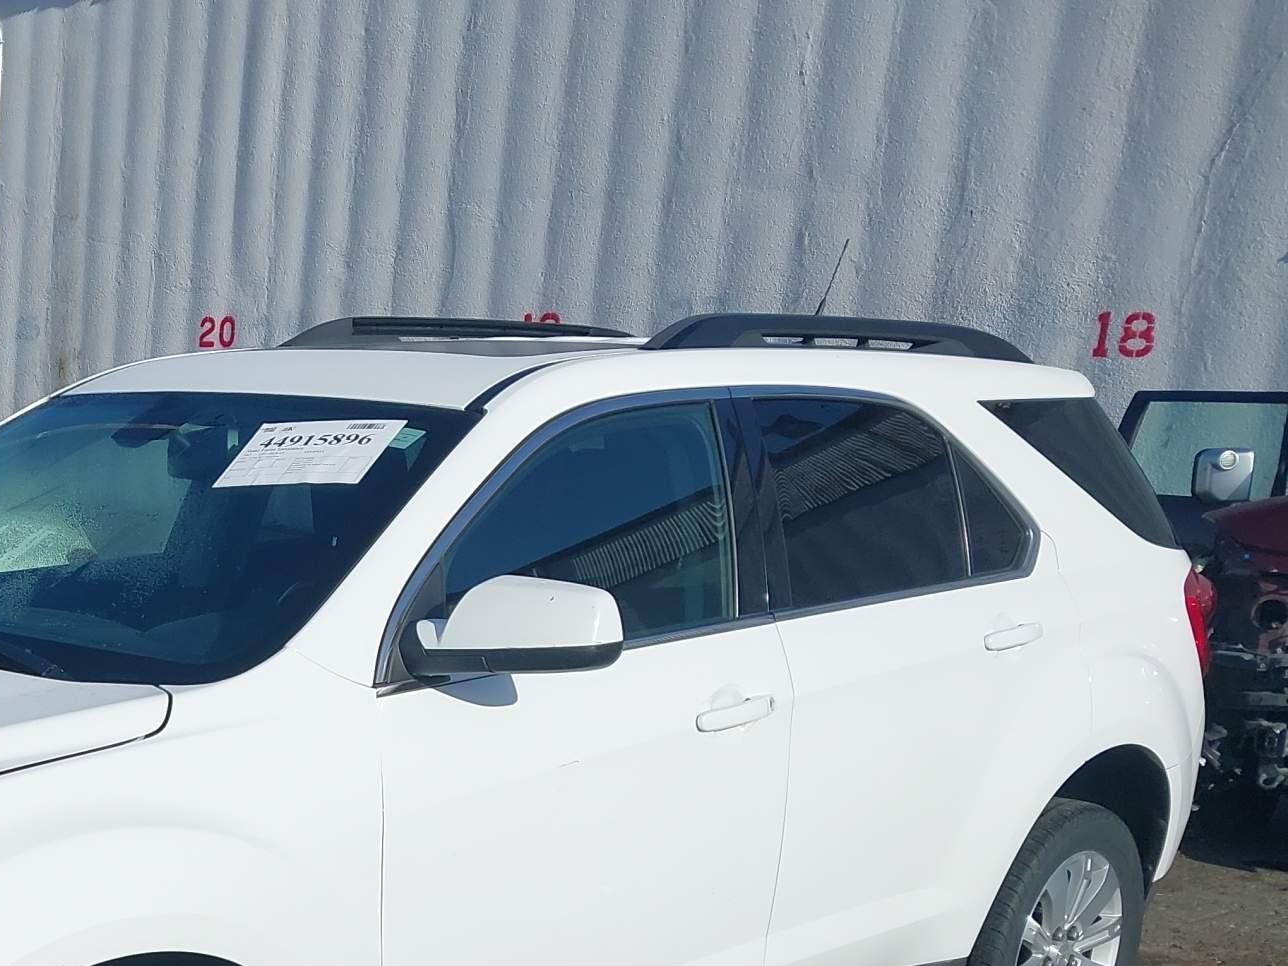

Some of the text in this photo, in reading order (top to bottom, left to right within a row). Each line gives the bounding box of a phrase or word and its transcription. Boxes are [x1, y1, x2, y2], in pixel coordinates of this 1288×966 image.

[199, 315, 236, 348] 20
[1091, 311, 1156, 360] 18
[260, 433, 375, 449] 44915896
